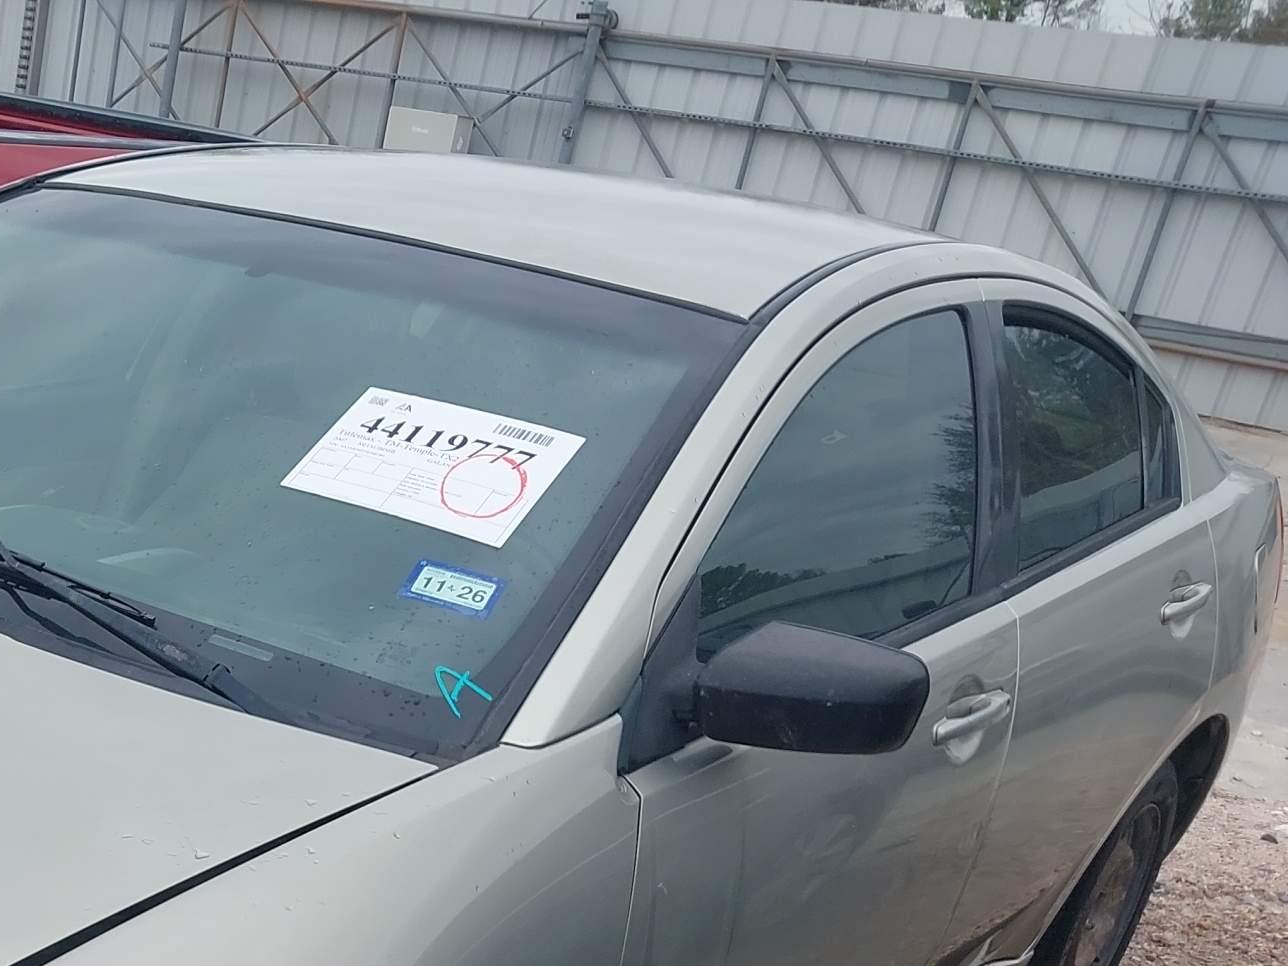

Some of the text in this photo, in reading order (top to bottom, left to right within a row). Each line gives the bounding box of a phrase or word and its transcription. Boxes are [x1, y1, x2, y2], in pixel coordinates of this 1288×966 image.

[360, 416, 537, 470] 44119777
[423, 576, 447, 593] 11
[456, 585, 488, 604] 26
[434, 665, 493, 719] A
